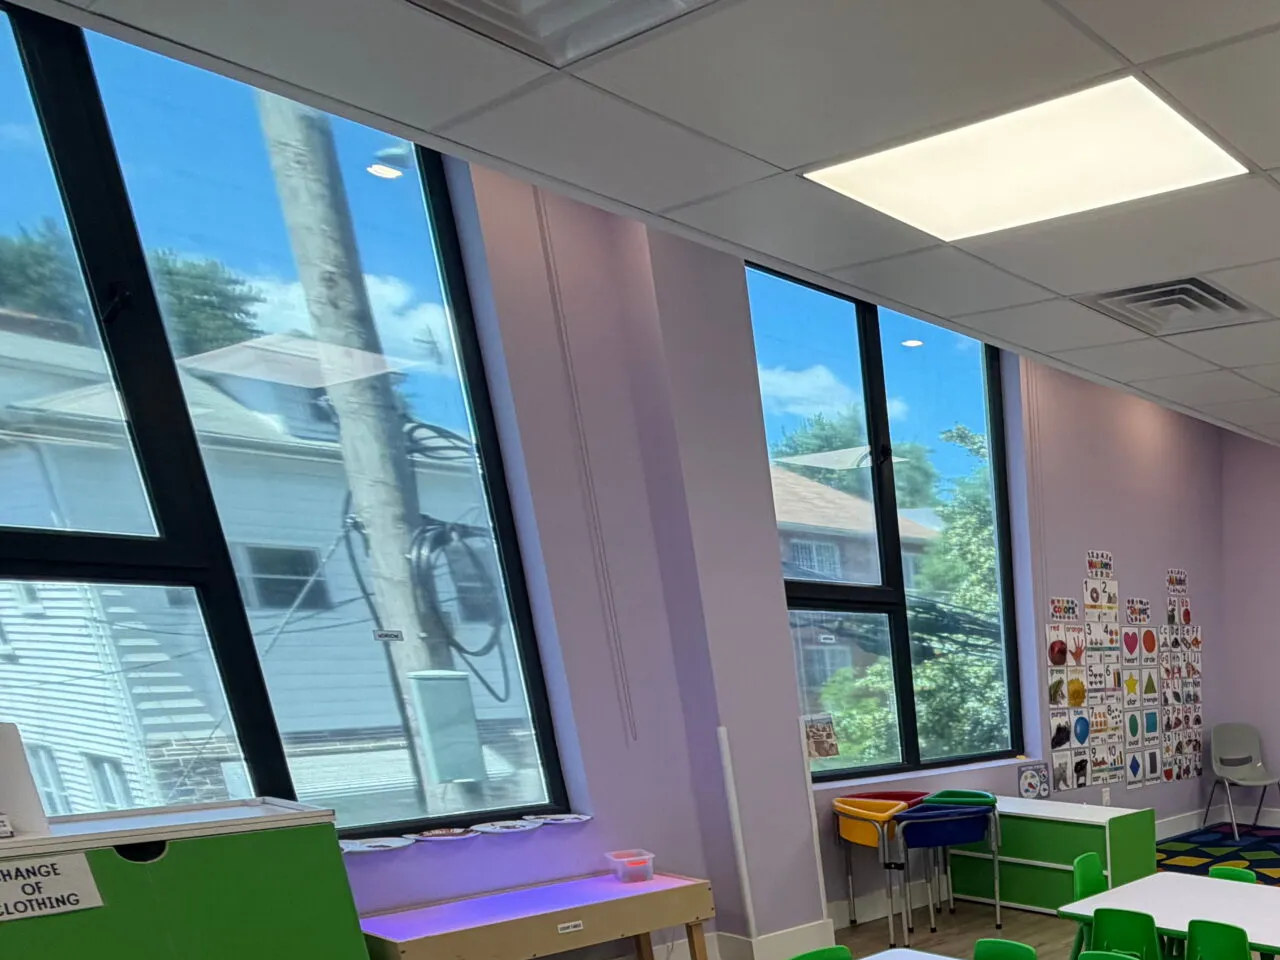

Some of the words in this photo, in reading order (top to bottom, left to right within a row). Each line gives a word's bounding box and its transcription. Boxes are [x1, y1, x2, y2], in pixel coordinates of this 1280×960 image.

[1102, 581, 1107, 593] 2
[1086, 624, 1092, 635] 3
[1103, 624, 1108, 635] 4
[1088, 666, 1093, 676] 5
[1106, 665, 1110, 676] 6
[1091, 747, 1096, 758] 9
[1108, 746, 1116, 756] 10
[0, 863, 61, 882] HANGE
[21, 882, 44, 896] OF
